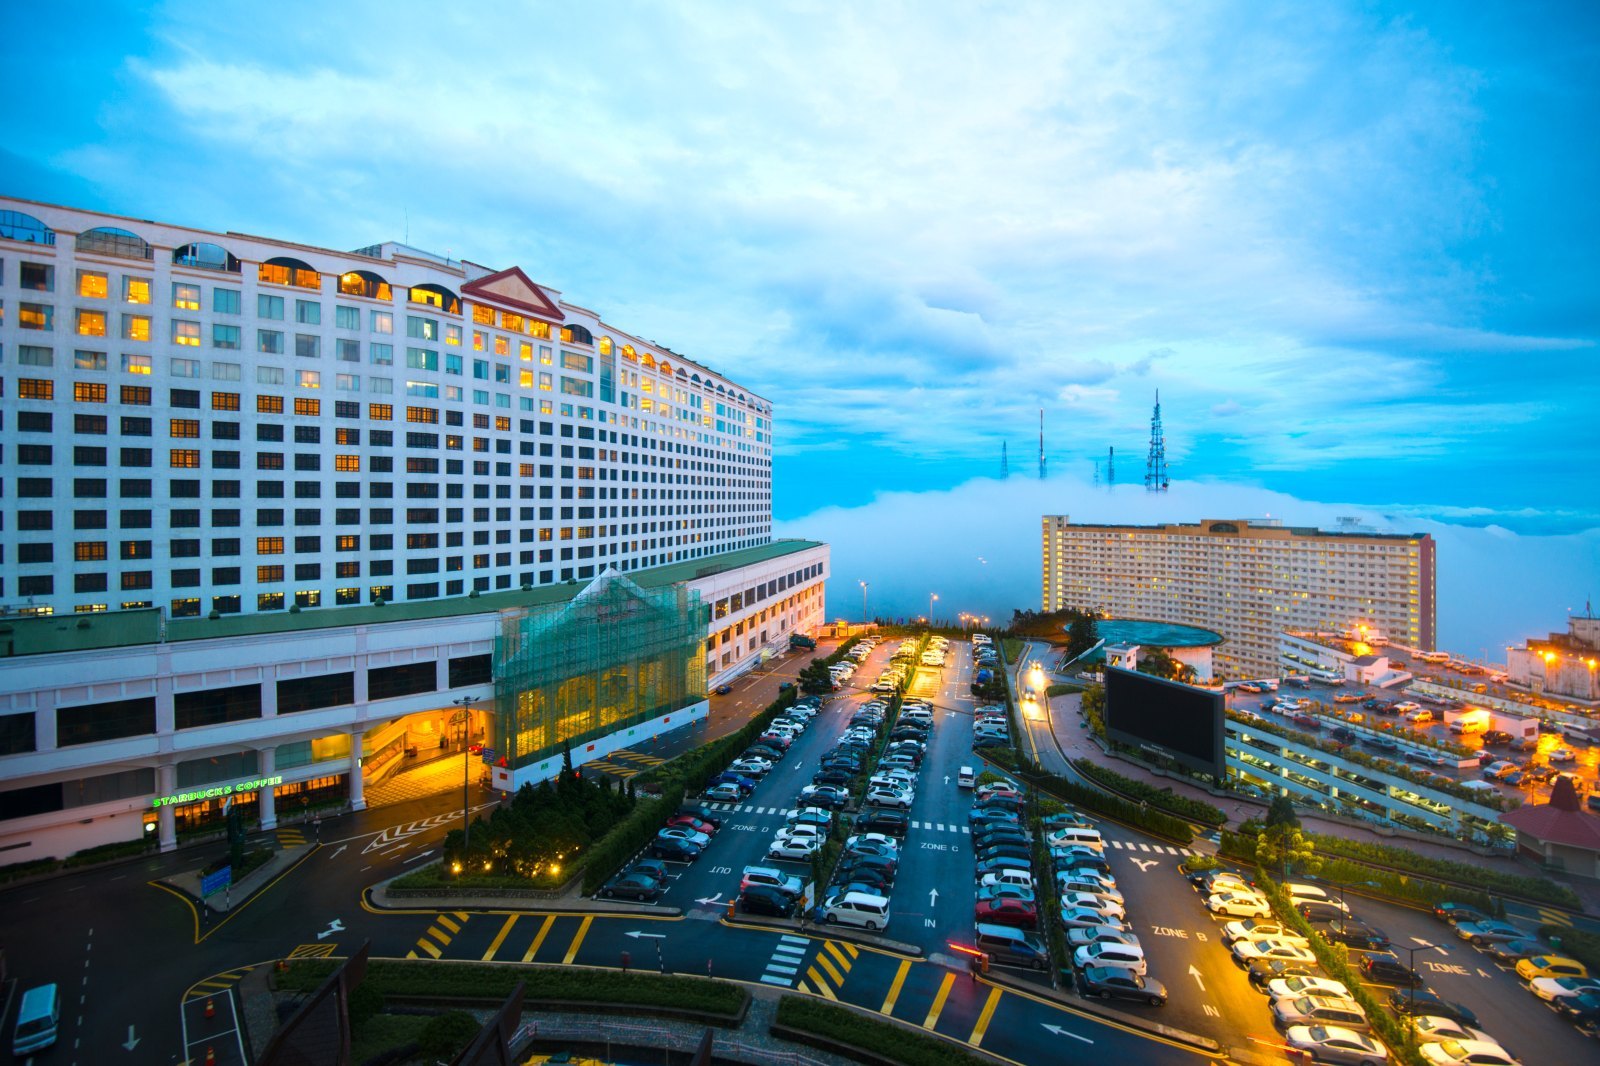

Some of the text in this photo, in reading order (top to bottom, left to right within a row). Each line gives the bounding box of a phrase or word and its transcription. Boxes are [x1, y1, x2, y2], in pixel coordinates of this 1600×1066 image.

[152, 776, 283, 807] STARBUCKS COFFEE
[731, 824, 758, 832] ZONE
[920, 842, 948, 851] ZONE
[708, 866, 732, 874] OUT
[924, 918, 936, 928] IN
[1151, 925, 1208, 942] ZONE B
[1422, 961, 1492, 978] ZONE A
[1202, 1004, 1220, 1018] IN
